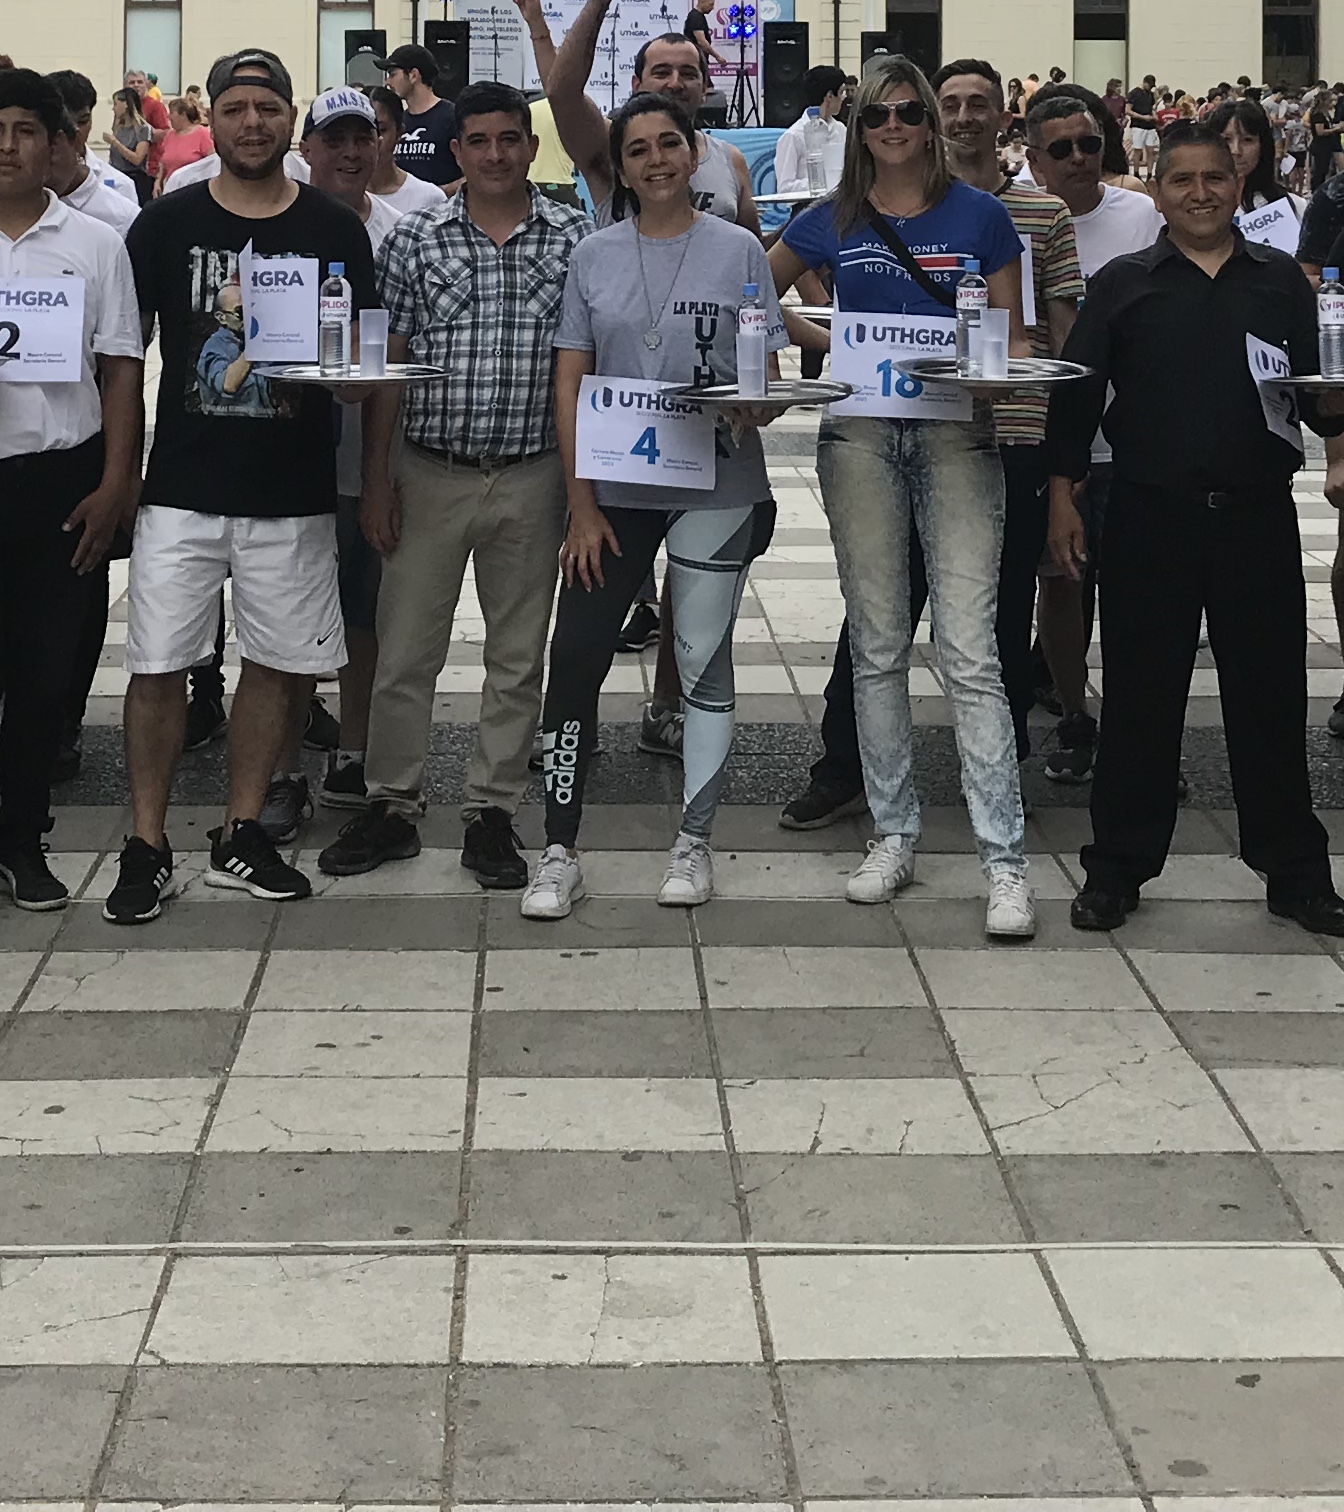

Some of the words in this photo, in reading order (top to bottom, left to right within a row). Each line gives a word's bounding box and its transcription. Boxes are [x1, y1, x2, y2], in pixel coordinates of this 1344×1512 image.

[864, 263, 891, 275] NOT
[673, 301, 687, 316] LA
[688, 301, 720, 317] PLATA
[872, 325, 956, 346] UTHGRA
[630, 426, 660, 465] 4
[553, 720, 581, 804] adidas
